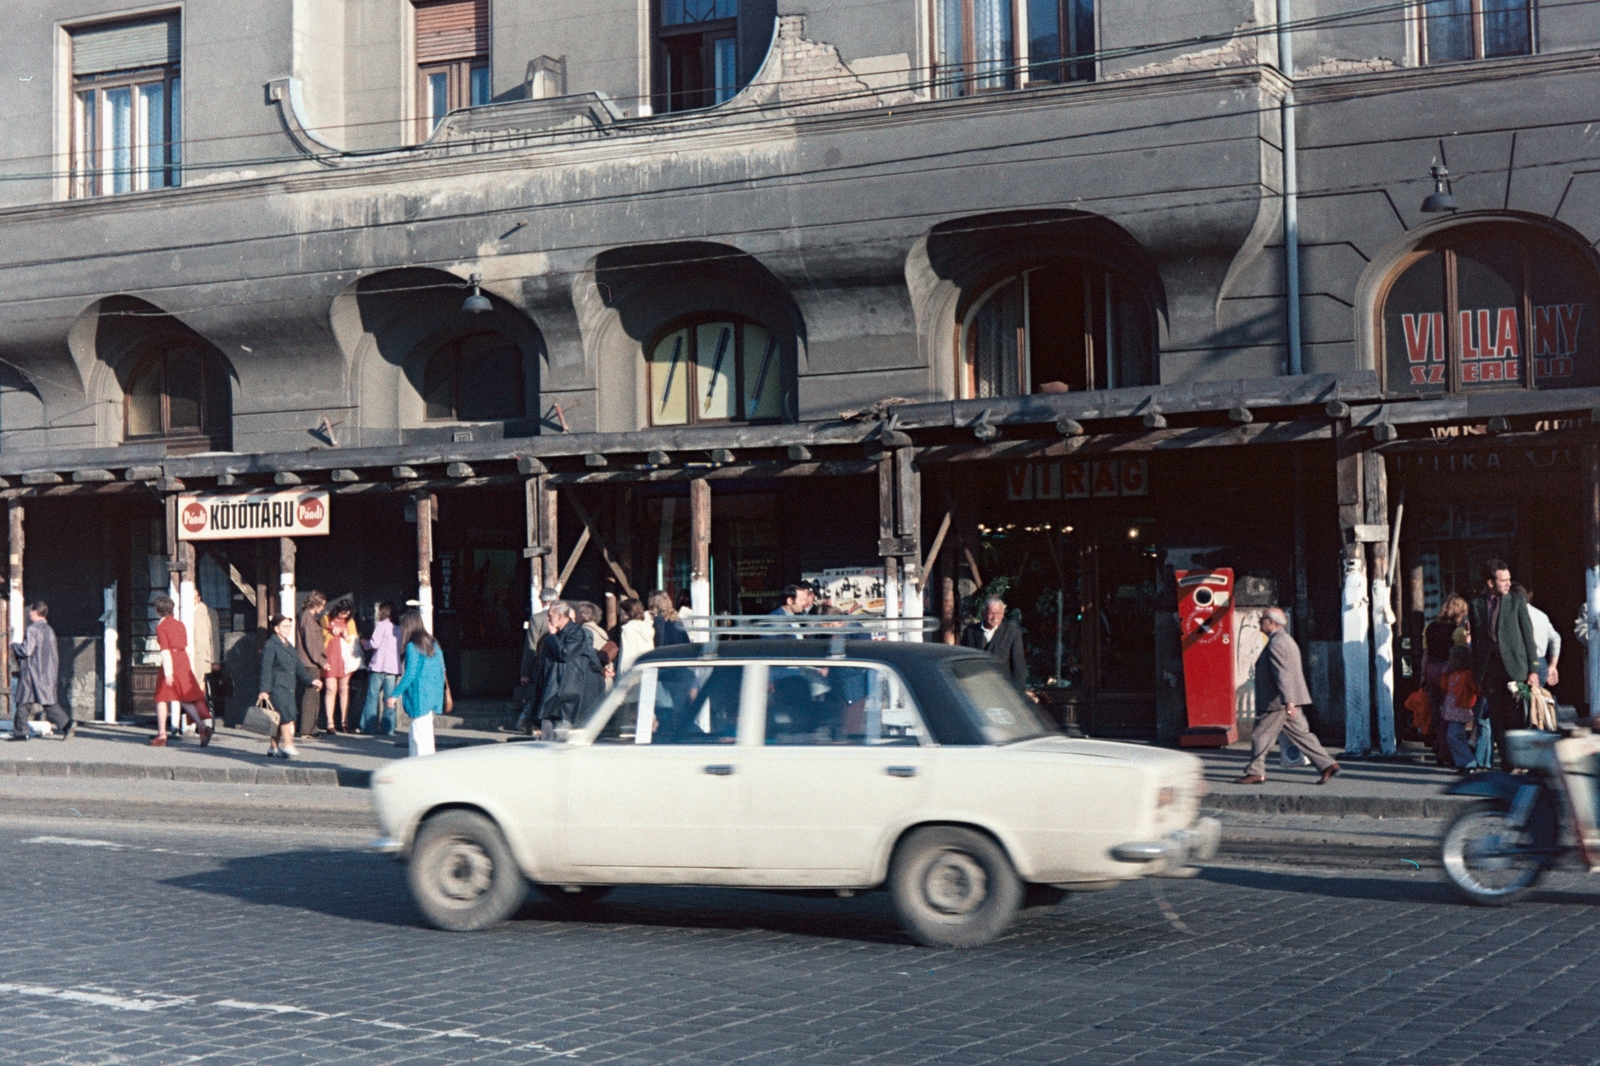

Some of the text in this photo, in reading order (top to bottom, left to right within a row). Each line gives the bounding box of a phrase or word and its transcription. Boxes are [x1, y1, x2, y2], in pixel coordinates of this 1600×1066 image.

[1402, 303, 1583, 363] VILLANY
[184, 510, 207, 527] Pándi
[210, 499, 294, 531] KÖTÖTTÁRU
[299, 504, 323, 521] Pándi
